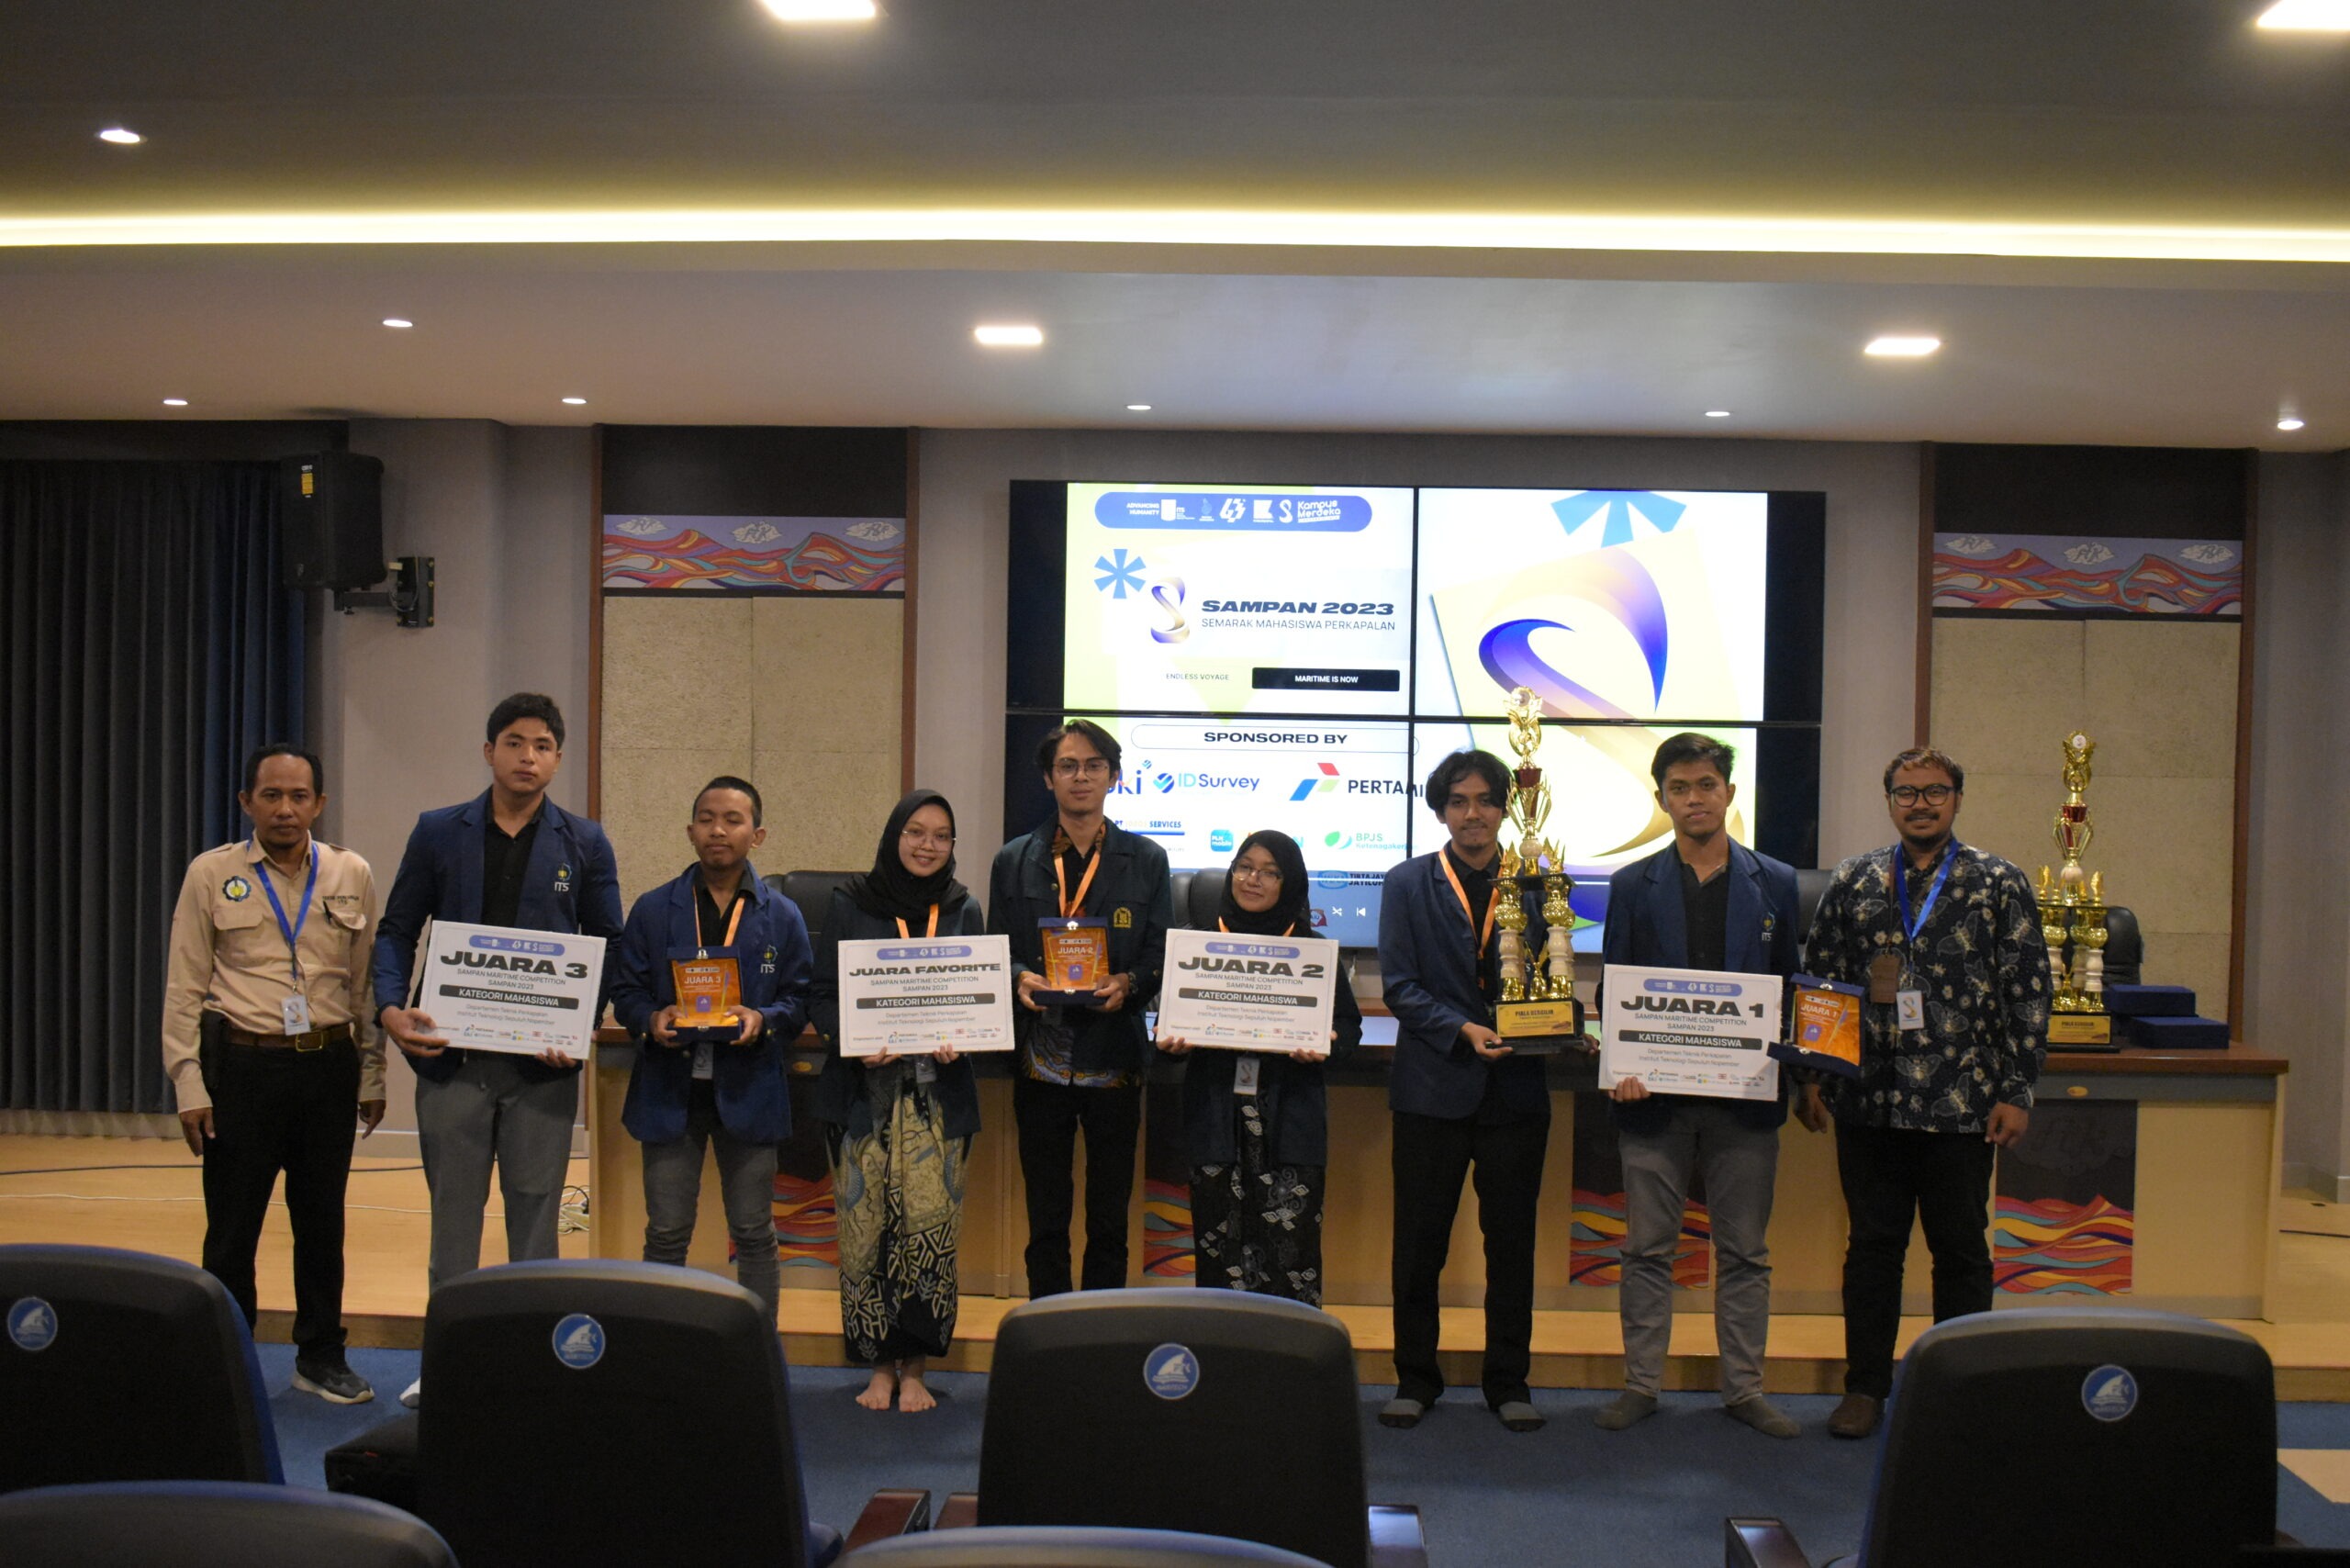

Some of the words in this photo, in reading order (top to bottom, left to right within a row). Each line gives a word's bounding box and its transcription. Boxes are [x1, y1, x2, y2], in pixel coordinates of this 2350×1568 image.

[1298, 499, 1338, 510] Kampus
[1298, 508, 1341, 518] Merdeka
[1201, 599, 1317, 614] SAMPAN
[1321, 602, 1394, 616] 2023
[1201, 618, 1254, 628] SEMARAK
[1256, 619, 1323, 630] MAHASISWA
[1325, 621, 1395, 631] PERKAPALAN
[1166, 672, 1199, 681] ENDLESS
[1200, 673, 1230, 681] VOYAGE
[1294, 675, 1331, 683] MARITIME
[1340, 676, 1359, 684] NOW
[1203, 731, 1322, 745] SPONSORED
[1324, 734, 1348, 745] BY
[1348, 779, 1423, 797] PERTAMI
[1356, 833, 1383, 842] BPJS
[554, 881, 570, 892] ITS
[1762, 933, 1772, 941] ITS
[441, 951, 556, 976] JUARA
[565, 962, 588, 979] 3
[760, 964, 777, 973] ITS
[848, 966, 911, 977] JUARA
[915, 963, 1002, 974] FAVORITE
[1178, 957, 1293, 977] JUARA
[1302, 964, 1324, 979] 2
[457, 968, 486, 978] SAMPAN
[487, 970, 519, 980] MARITIME
[520, 974, 566, 986] COMPETITION
[684, 975, 714, 984] JUARA
[716, 975, 722, 983] 3
[900, 977, 932, 985] MARITIME
[933, 975, 979, 984] COMPETITION
[1195, 972, 1224, 980] SAMPAN
[1224, 974, 1256, 982] MARITIME
[1257, 976, 1304, 985] COMPETITION
[488, 979, 516, 989] SAMPAN
[459, 988, 503, 1001] KATEGORI
[505, 993, 559, 1006] MAHASISWA
[876, 998, 920, 1007] KATEGORI
[922, 996, 976, 1005] MAHASISWA
[1198, 991, 1242, 1002] KATEGORI
[1243, 994, 1298, 1005] MAHASISWA
[1620, 995, 1740, 1017] JUARA
[1748, 1002, 1763, 1018] 1
[1801, 1004, 1830, 1016] JUARA
[1634, 1013, 1663, 1021] SAMPAN
[1664, 1014, 1697, 1023] MARITIME
[1699, 1016, 1747, 1025] COMPETITION
[1667, 1023, 1696, 1031] SAMPAN
[1639, 1033, 1684, 1044] KATEGORI
[1685, 1036, 1742, 1047] MAHASISWA
